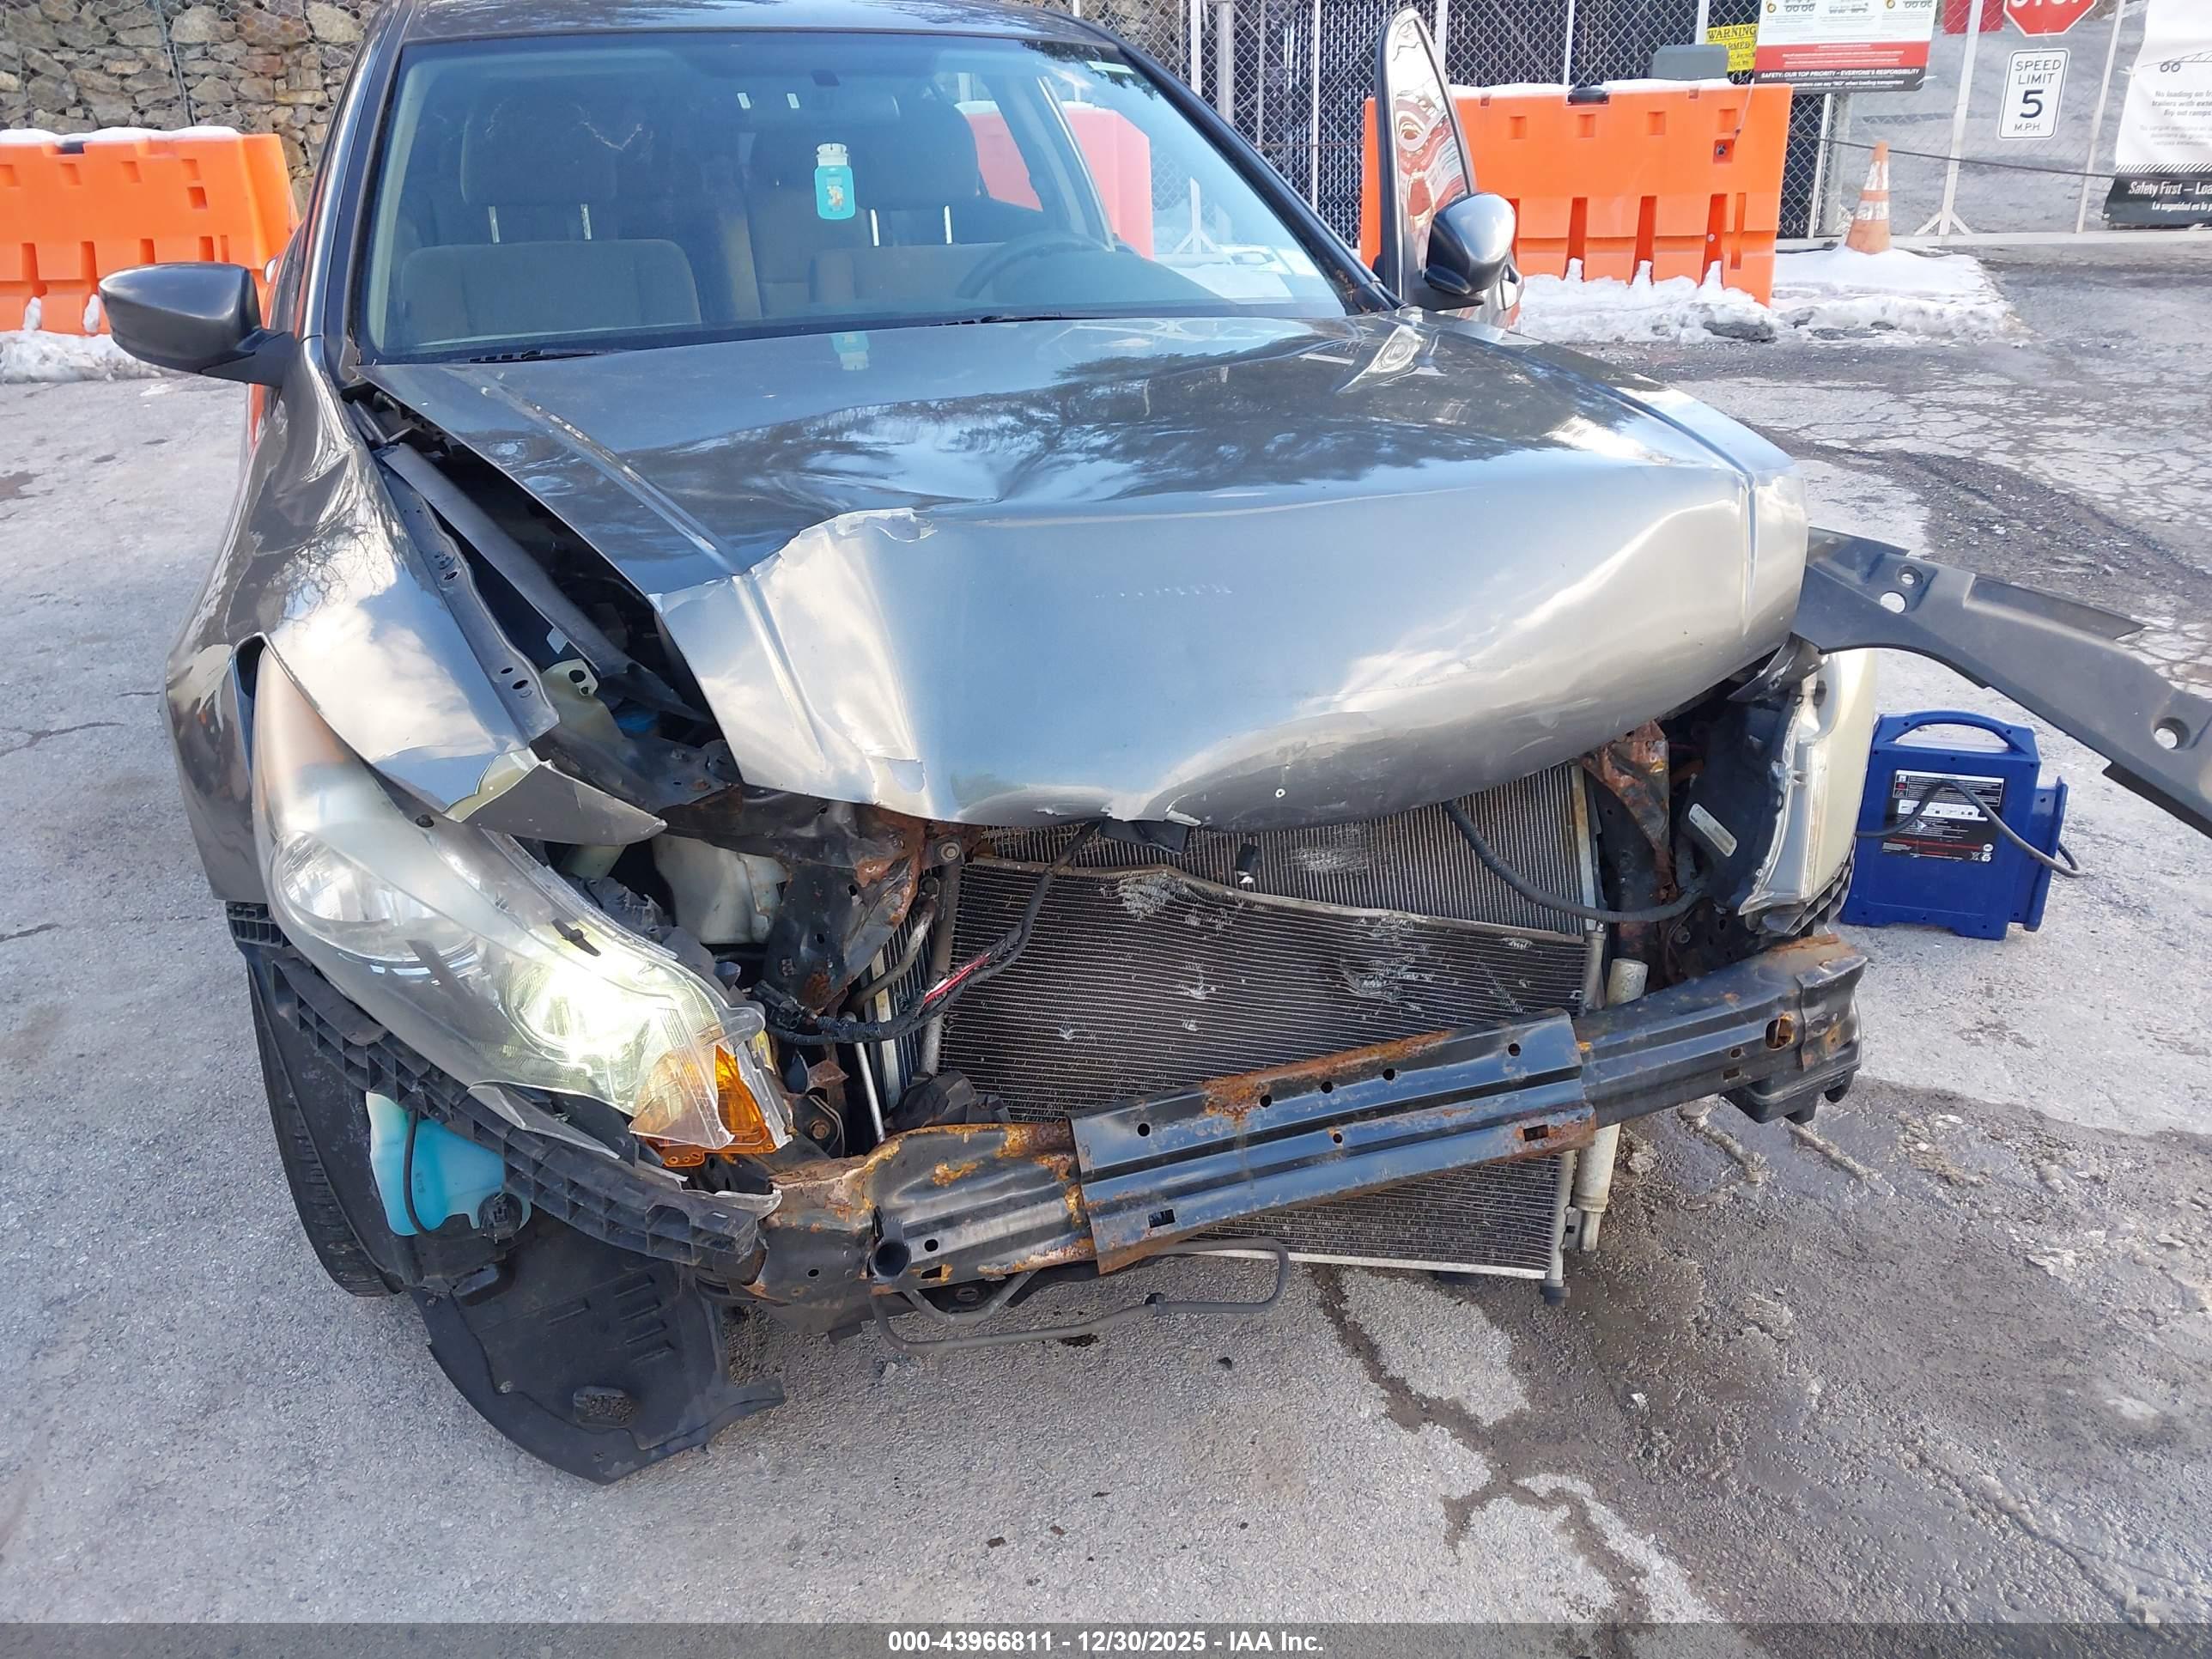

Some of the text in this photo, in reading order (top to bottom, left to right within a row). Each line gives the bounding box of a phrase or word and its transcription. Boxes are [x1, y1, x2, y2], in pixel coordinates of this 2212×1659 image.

[1707, 26, 1756, 40] WARNING
[2014, 59, 2062, 72] SPEED
[2018, 73, 2055, 85] LIMIT
[2019, 88, 2045, 118] 5
[2129, 181, 2158, 198] Safety
[2160, 181, 2183, 195] First
